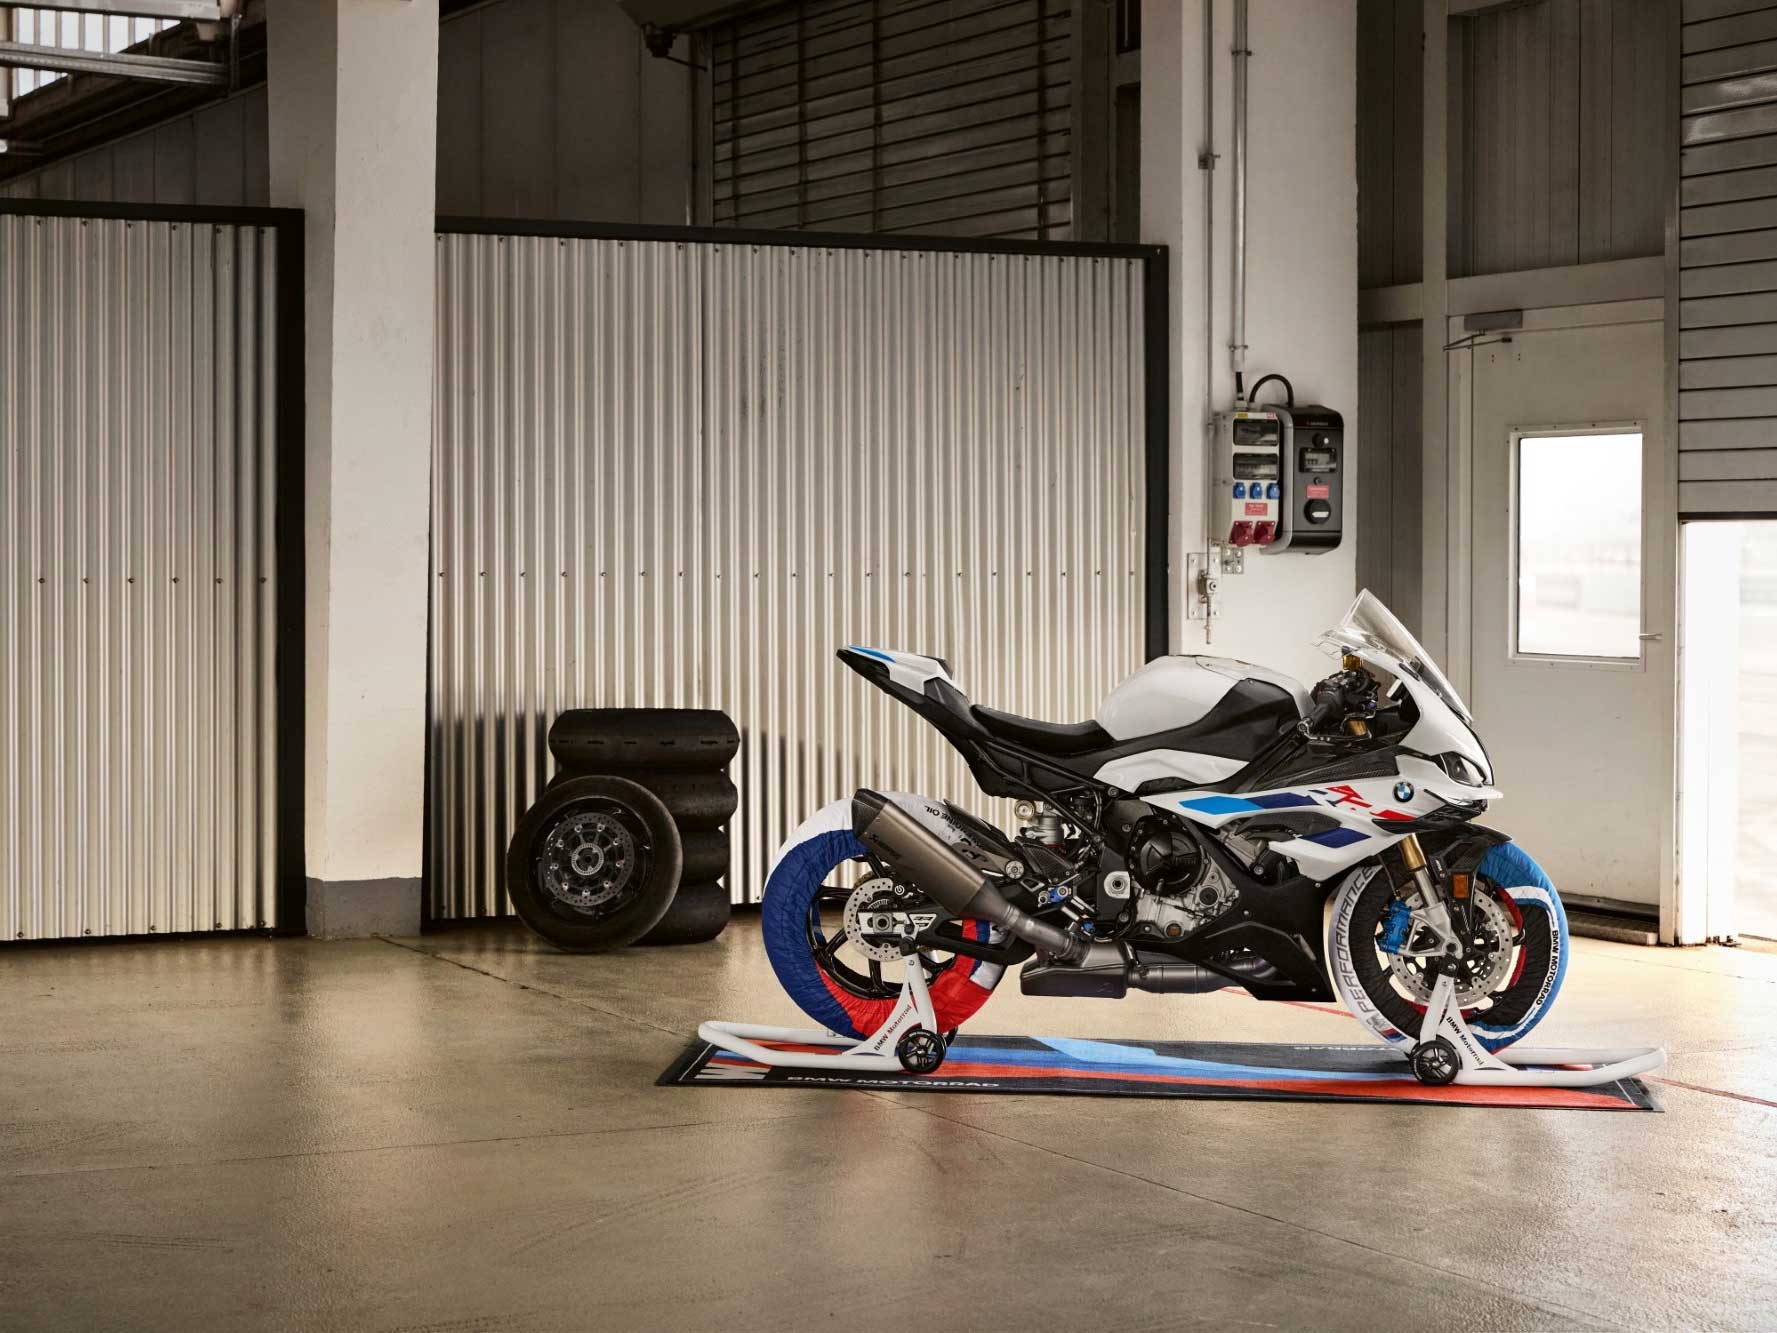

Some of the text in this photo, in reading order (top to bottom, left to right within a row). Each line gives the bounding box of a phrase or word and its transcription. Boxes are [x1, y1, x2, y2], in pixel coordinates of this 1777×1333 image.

[924, 805, 941, 817] OIL
[1335, 866, 1375, 1013] PERFORMANCE
[1536, 955, 1559, 1006] MOTORRAD
[874, 1034, 889, 1051] BMW
[1446, 1016, 1485, 1067] BMW Motorrad
[857, 1079, 1000, 1087] MOTORRAD
